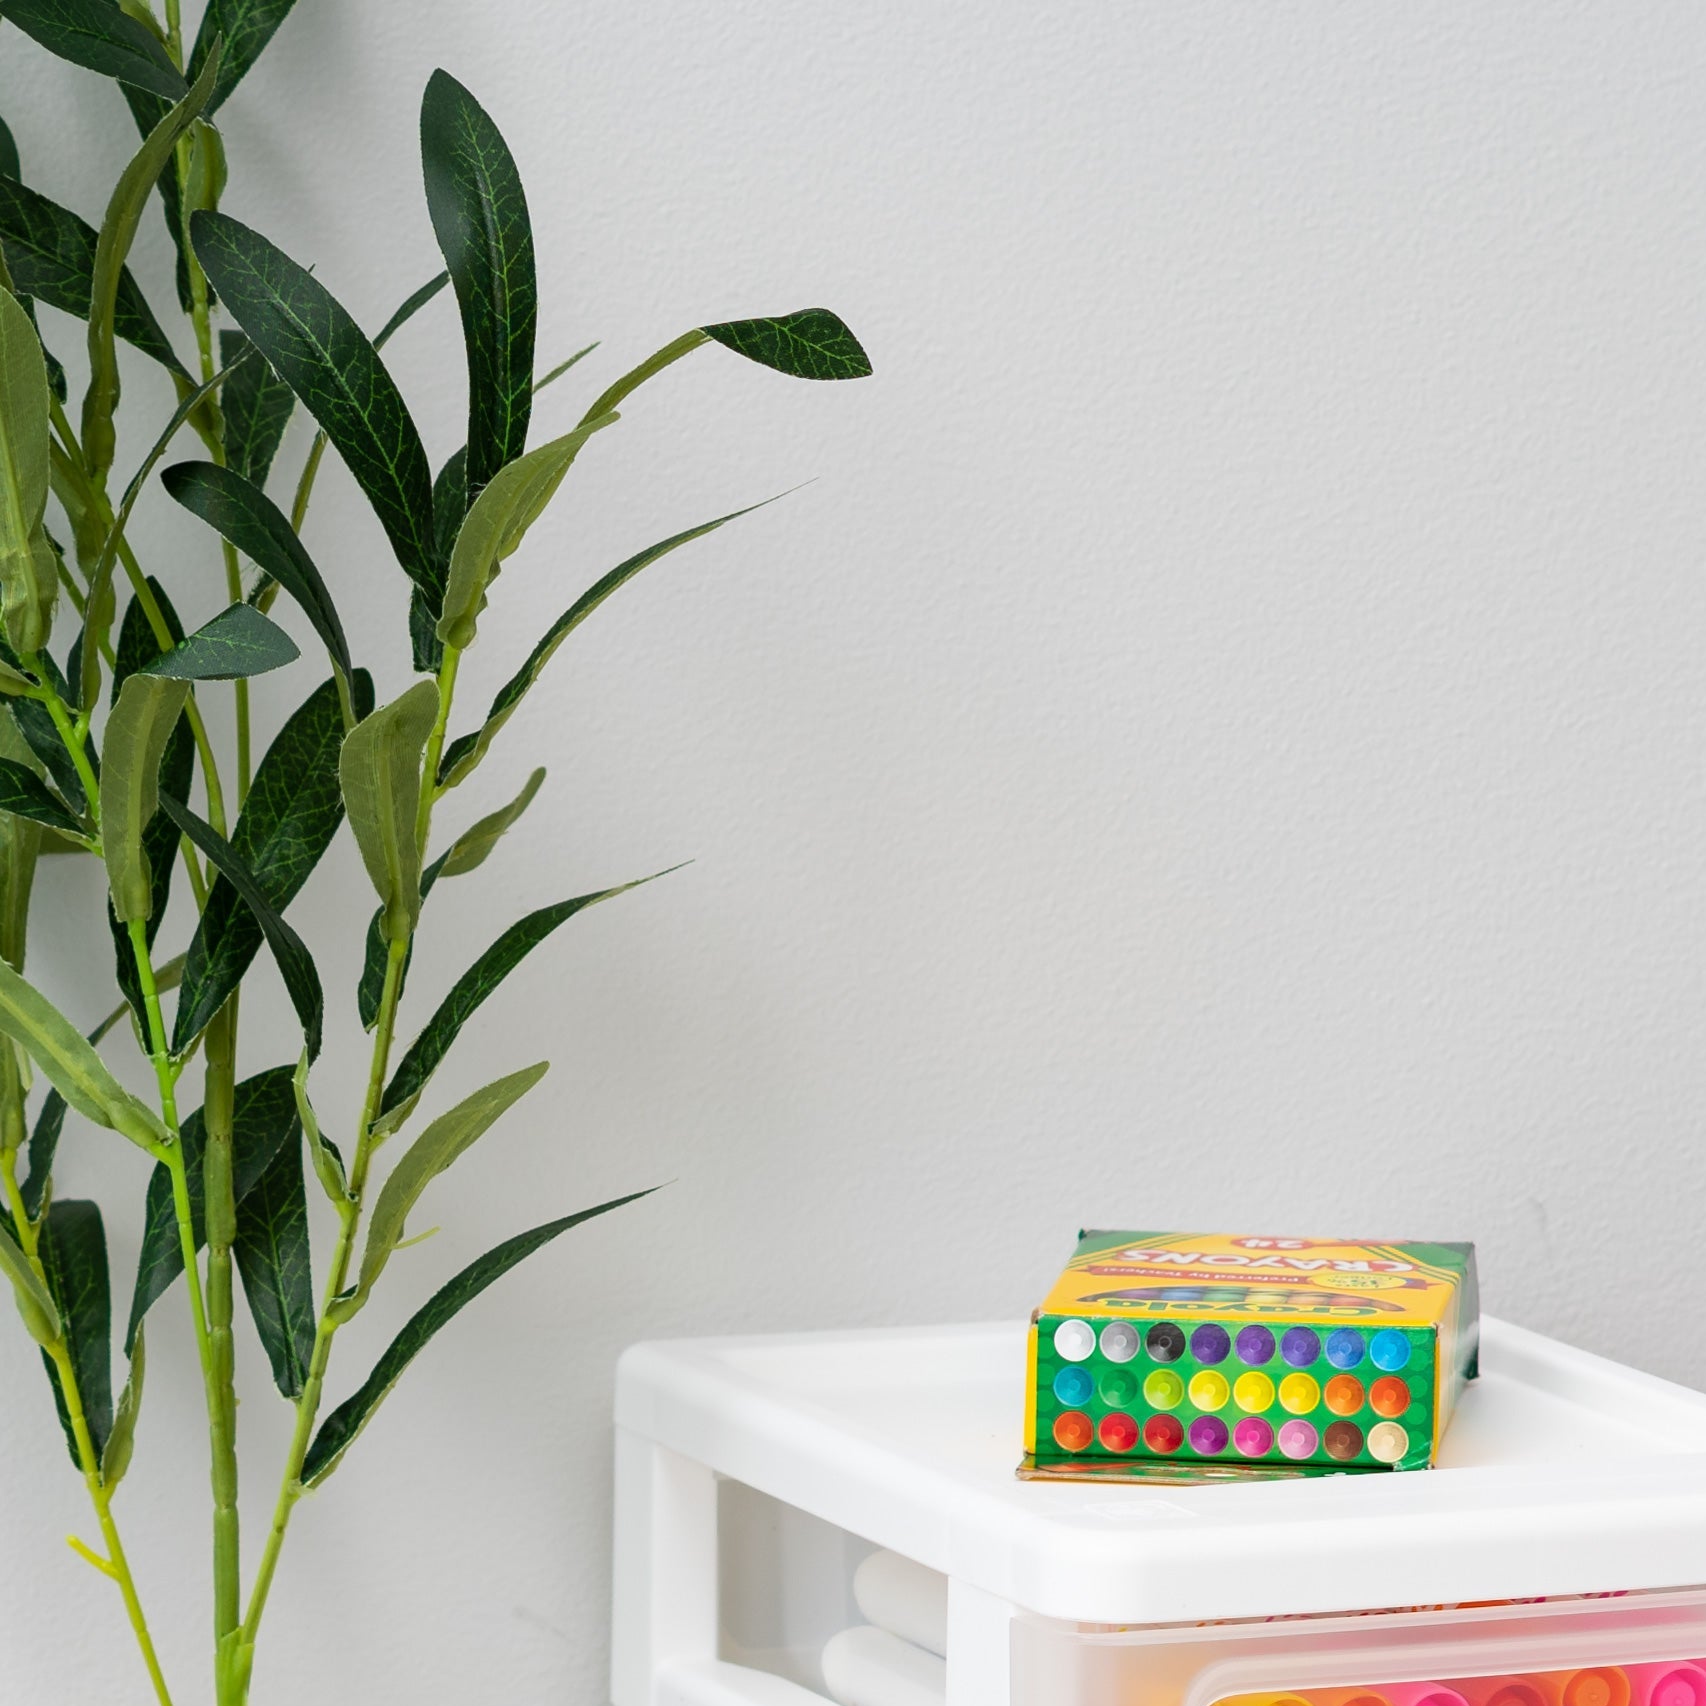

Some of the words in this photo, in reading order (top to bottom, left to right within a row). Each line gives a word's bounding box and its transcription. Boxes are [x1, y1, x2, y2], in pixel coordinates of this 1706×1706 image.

[1240, 1238, 1304, 1249] 24
[1118, 1249, 1415, 1272] CRAYONS
[1188, 1271, 1211, 1280] by
[1213, 1273, 1299, 1283] Preferred
[1104, 1299, 1379, 1317] Crayola
